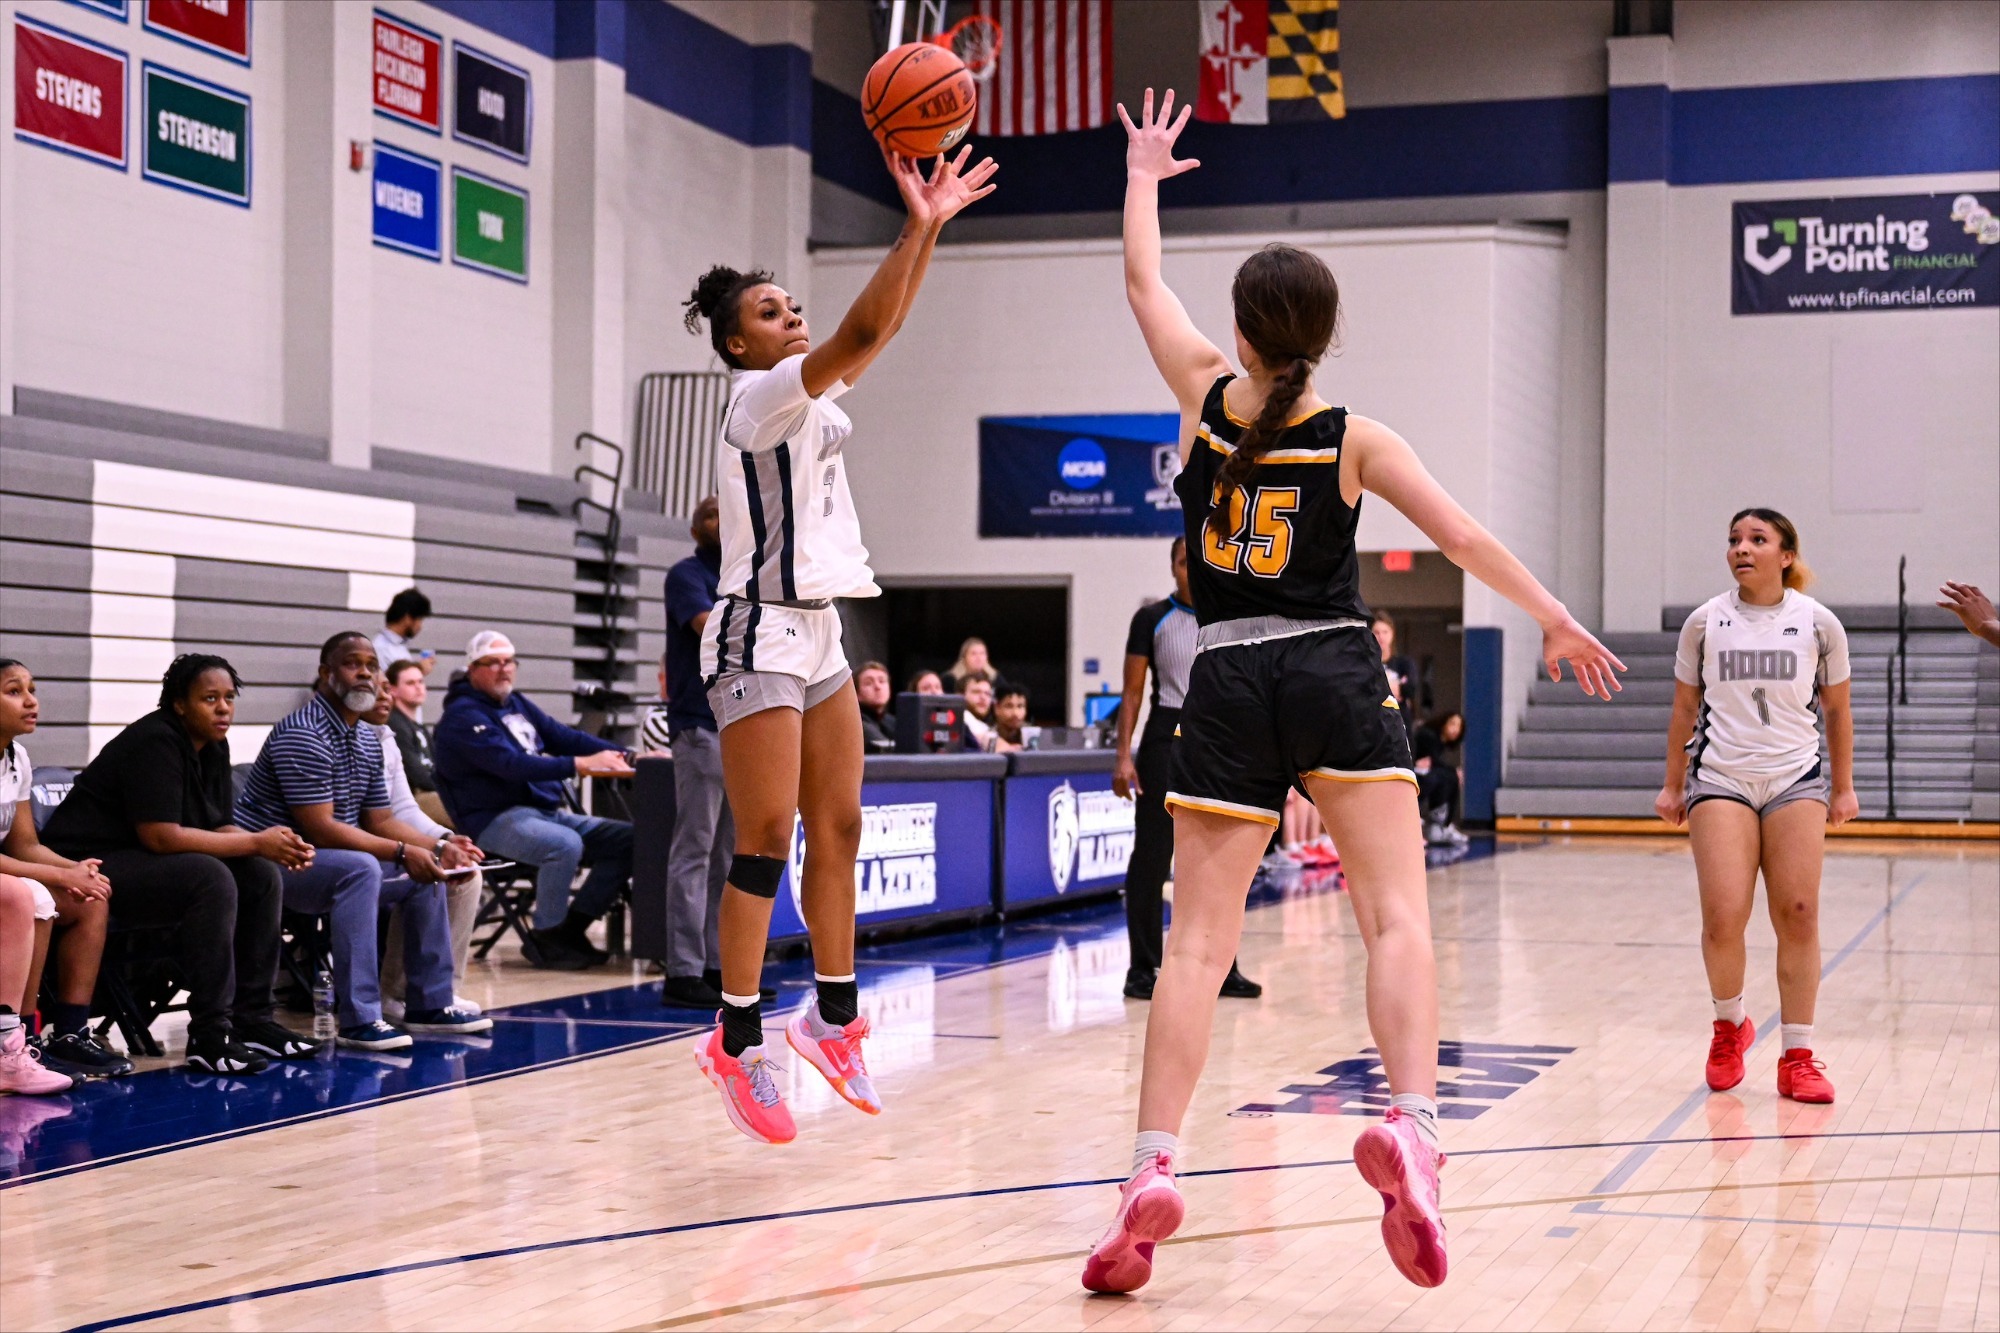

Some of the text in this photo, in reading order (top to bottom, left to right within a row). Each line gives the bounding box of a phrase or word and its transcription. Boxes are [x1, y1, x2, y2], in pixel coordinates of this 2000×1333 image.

[36, 66, 102, 118] STEVENS
[158, 109, 236, 162] STEVENSON
[375, 179, 424, 219] WIDENER
[1799, 214, 1929, 251] Turning
[1805, 245, 1978, 273] Point FINANCIAL
[1787, 285, 1976, 309] www.tpfinancial.com
[1202, 483, 1300, 578] 25
[1718, 649, 1798, 682] HOOD
[1751, 687, 1771, 726] 1
[854, 854, 937, 914] LAZERS
